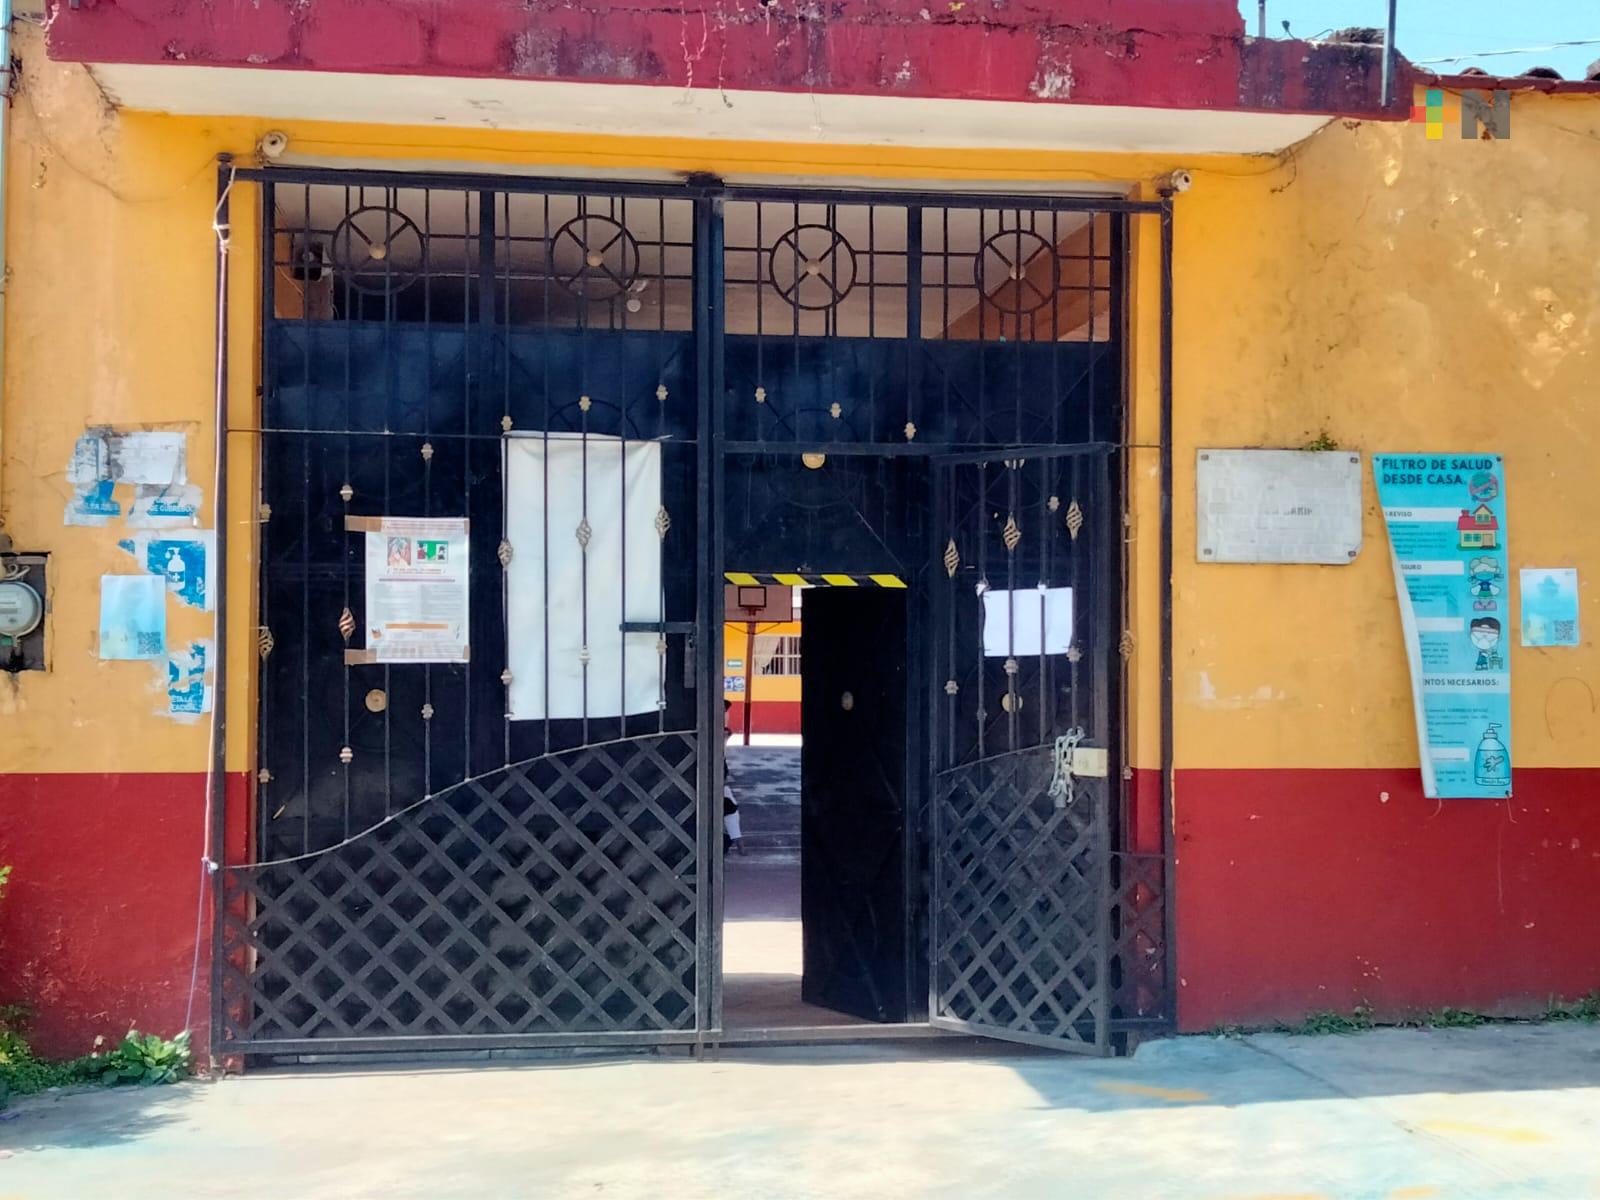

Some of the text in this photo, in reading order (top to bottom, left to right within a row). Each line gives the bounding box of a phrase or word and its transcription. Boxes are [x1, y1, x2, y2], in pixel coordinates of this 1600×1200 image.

[1382, 458, 1493, 471] FILTRO DE SALUD
[1383, 473, 1467, 485] DESDE CASA.
